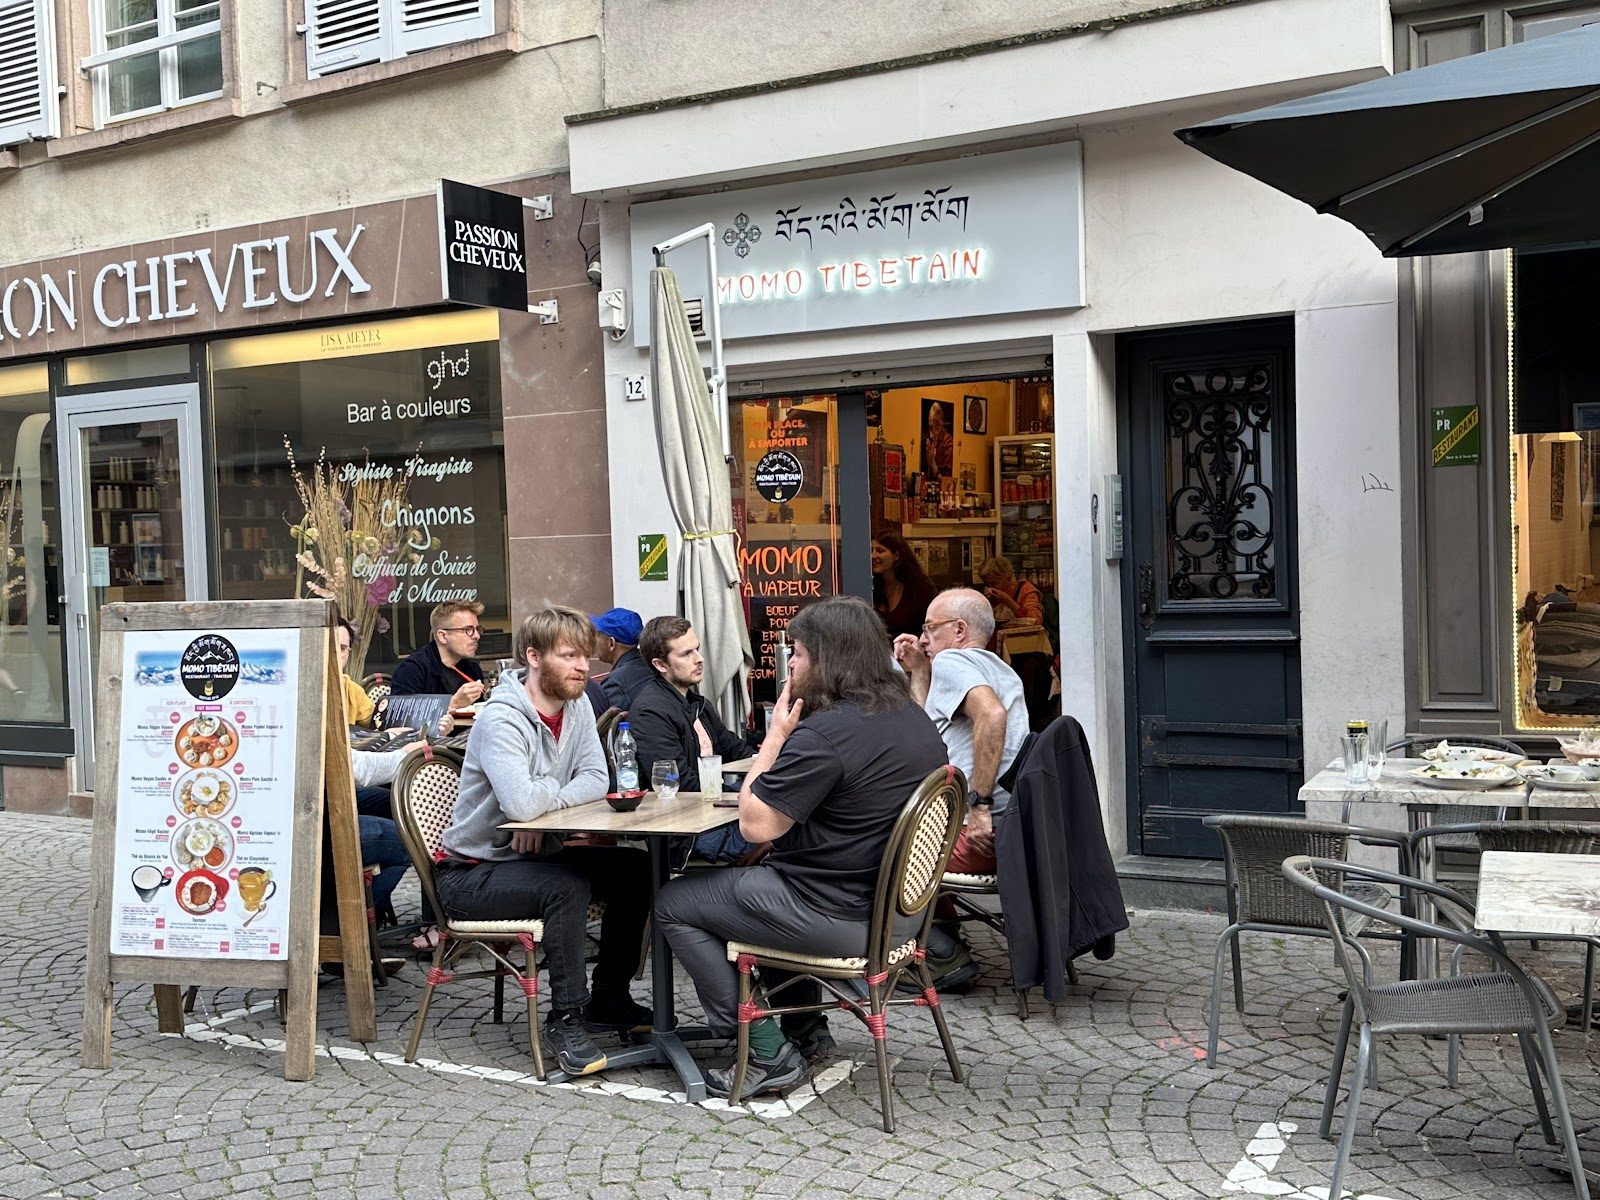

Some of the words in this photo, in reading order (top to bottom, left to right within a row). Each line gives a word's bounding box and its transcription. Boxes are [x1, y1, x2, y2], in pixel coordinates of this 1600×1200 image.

[455, 220, 518, 251] PASSION
[450, 242, 525, 273] CHEVEUX
[0, 269, 77, 340] ON
[93, 223, 371, 328] CHEVEUX
[717, 268, 804, 303] MOMO
[819, 248, 982, 290] TIBETAIN
[321, 333, 342, 346] LISA
[346, 328, 381, 343] MEYER
[427, 349, 470, 390] ghd
[628, 380, 642, 394] 12
[347, 403, 376, 423] Bar
[381, 399, 392, 420] à
[396, 396, 471, 419] couleurs
[774, 419, 805, 429] PLACE
[1436, 419, 1450, 431] PR
[758, 437, 808, 448] EMPORTER
[1433, 410, 1477, 464] RESTAURANT
[339, 462, 394, 487] Styliste
[404, 456, 473, 482] Visagiste
[756, 474, 774, 482] MOMO
[380, 499, 475, 550] Chignons
[641, 544, 650, 552] PR
[352, 553, 407, 584] Coiffures
[410, 554, 428, 576] de
[431, 550, 476, 576] Soirée
[740, 545, 822, 576] MOMO
[388, 582, 403, 603] et
[759, 579, 821, 597] VAPEUR
[765, 605, 799, 617] BOEUF
[769, 618, 790, 629] POR
[182, 664, 205, 673] MOMO
[205, 662, 238, 673] TIBÉTAIN
